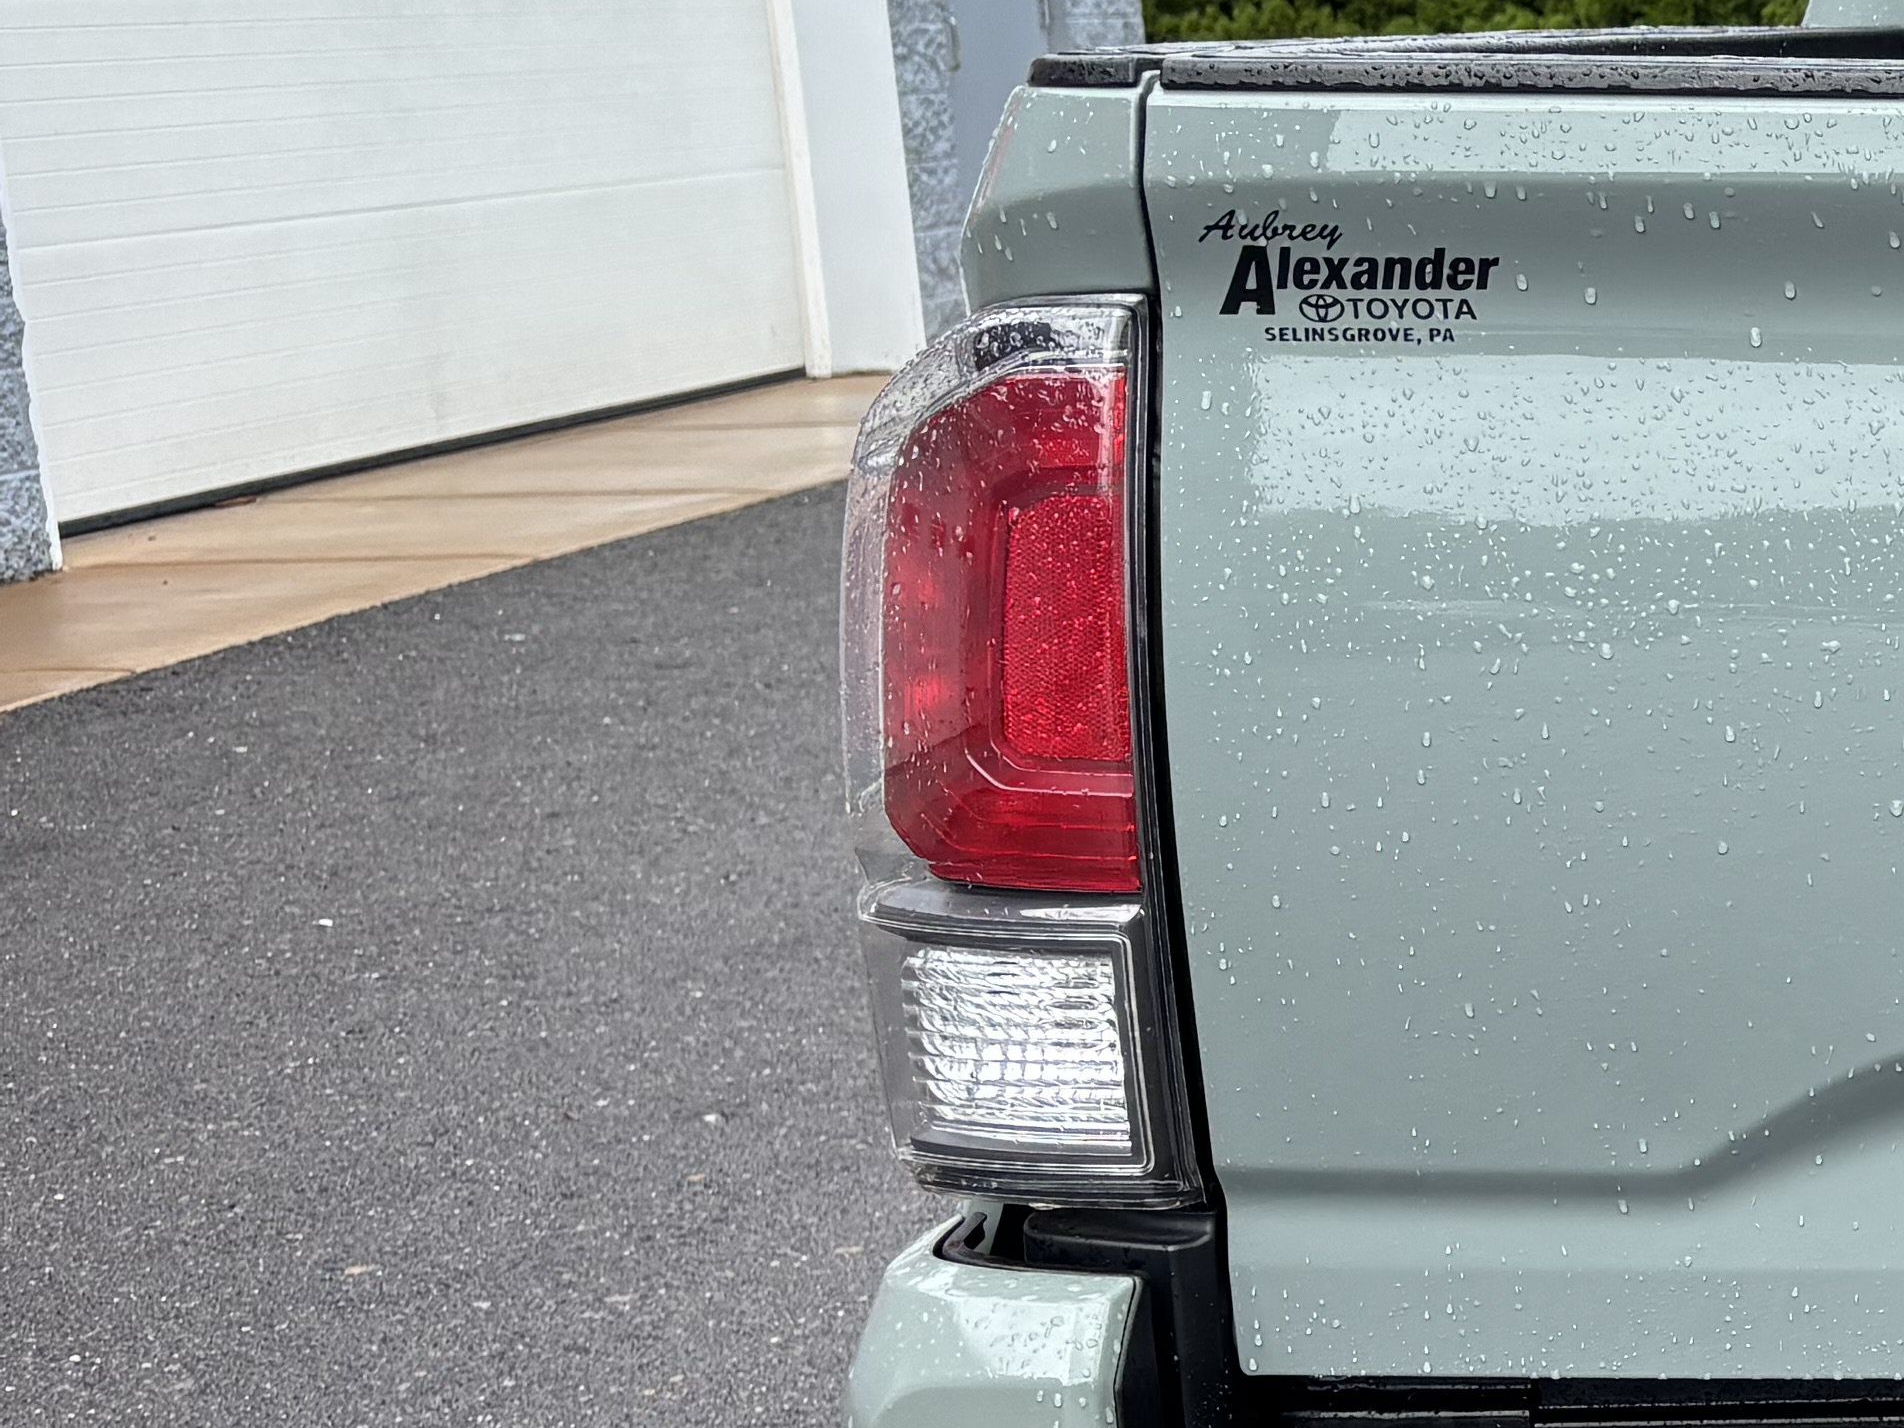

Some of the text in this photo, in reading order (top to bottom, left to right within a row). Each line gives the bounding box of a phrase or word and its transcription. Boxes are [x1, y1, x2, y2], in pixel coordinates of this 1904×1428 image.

[1199, 209, 1343, 249] Aubrey
[1219, 245, 1499, 315] Alexander
[1347, 298, 1478, 320] TOYOTA
[1265, 327, 1455, 346] SELINSGROVE, PA
